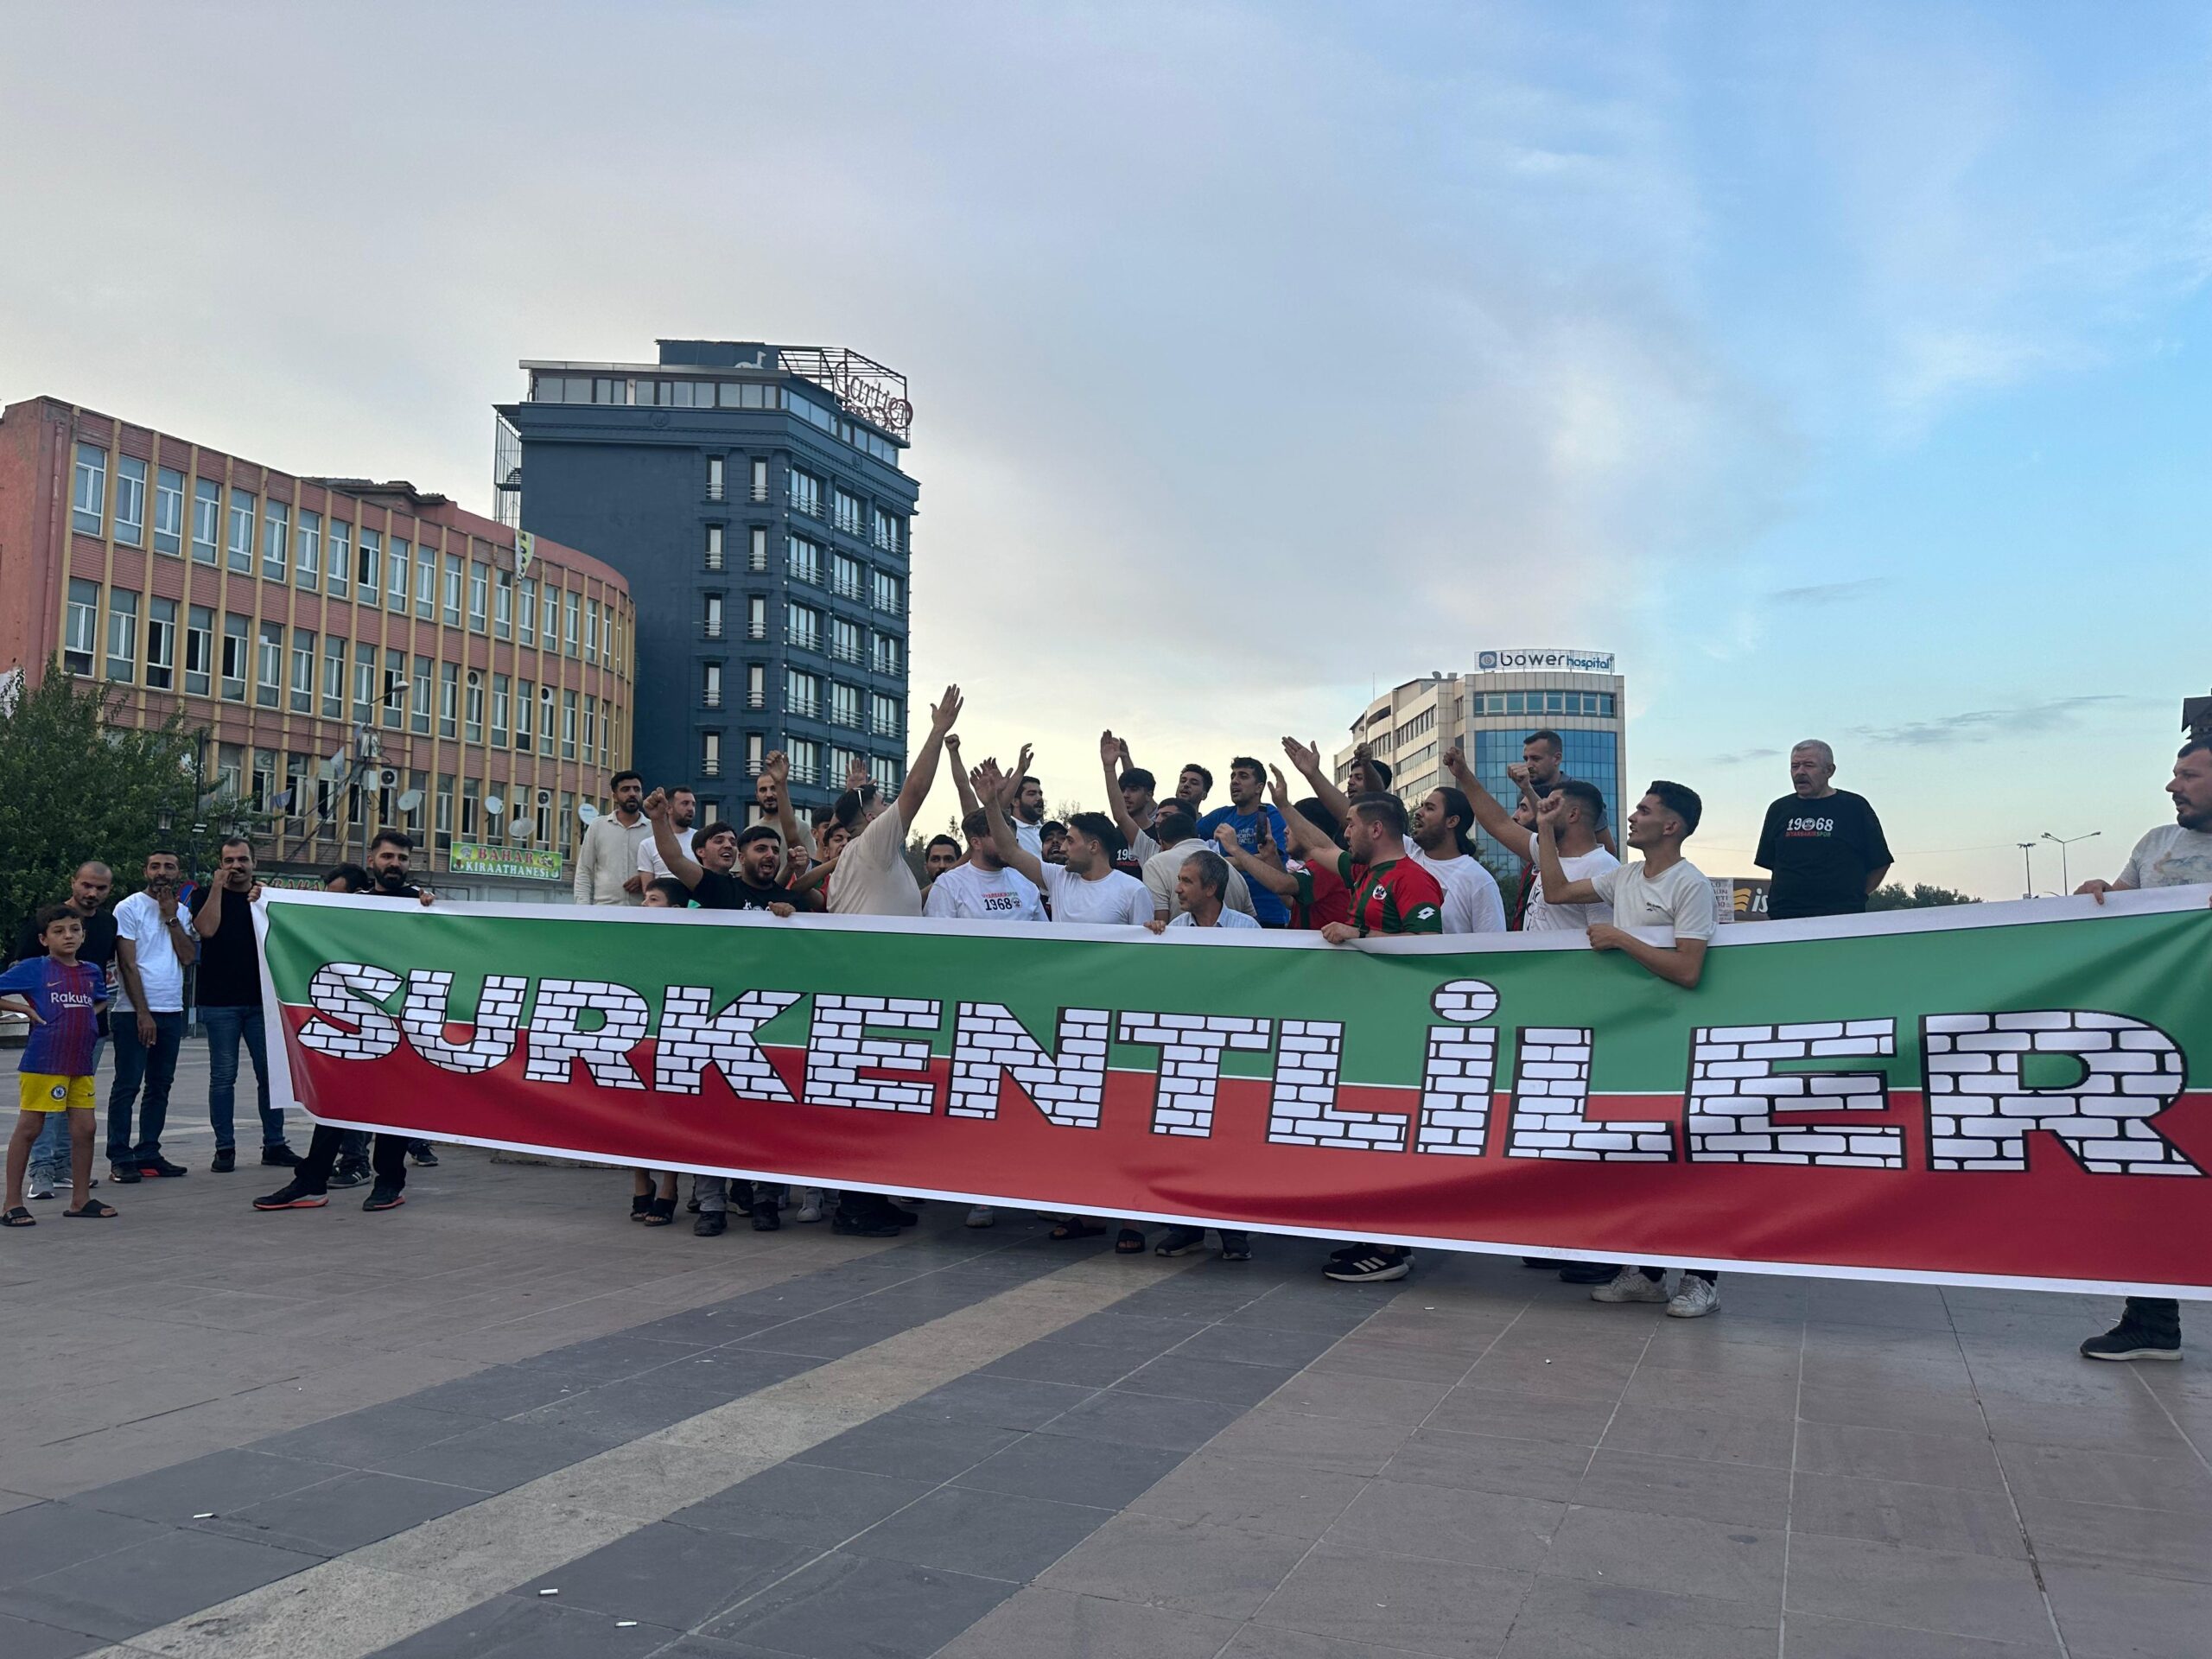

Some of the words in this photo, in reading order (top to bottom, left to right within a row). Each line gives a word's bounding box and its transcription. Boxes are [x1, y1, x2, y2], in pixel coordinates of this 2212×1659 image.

[1567, 655, 1610, 671] hospital
[478, 846, 534, 864] BAHAR
[984, 898, 1013, 911] 1968
